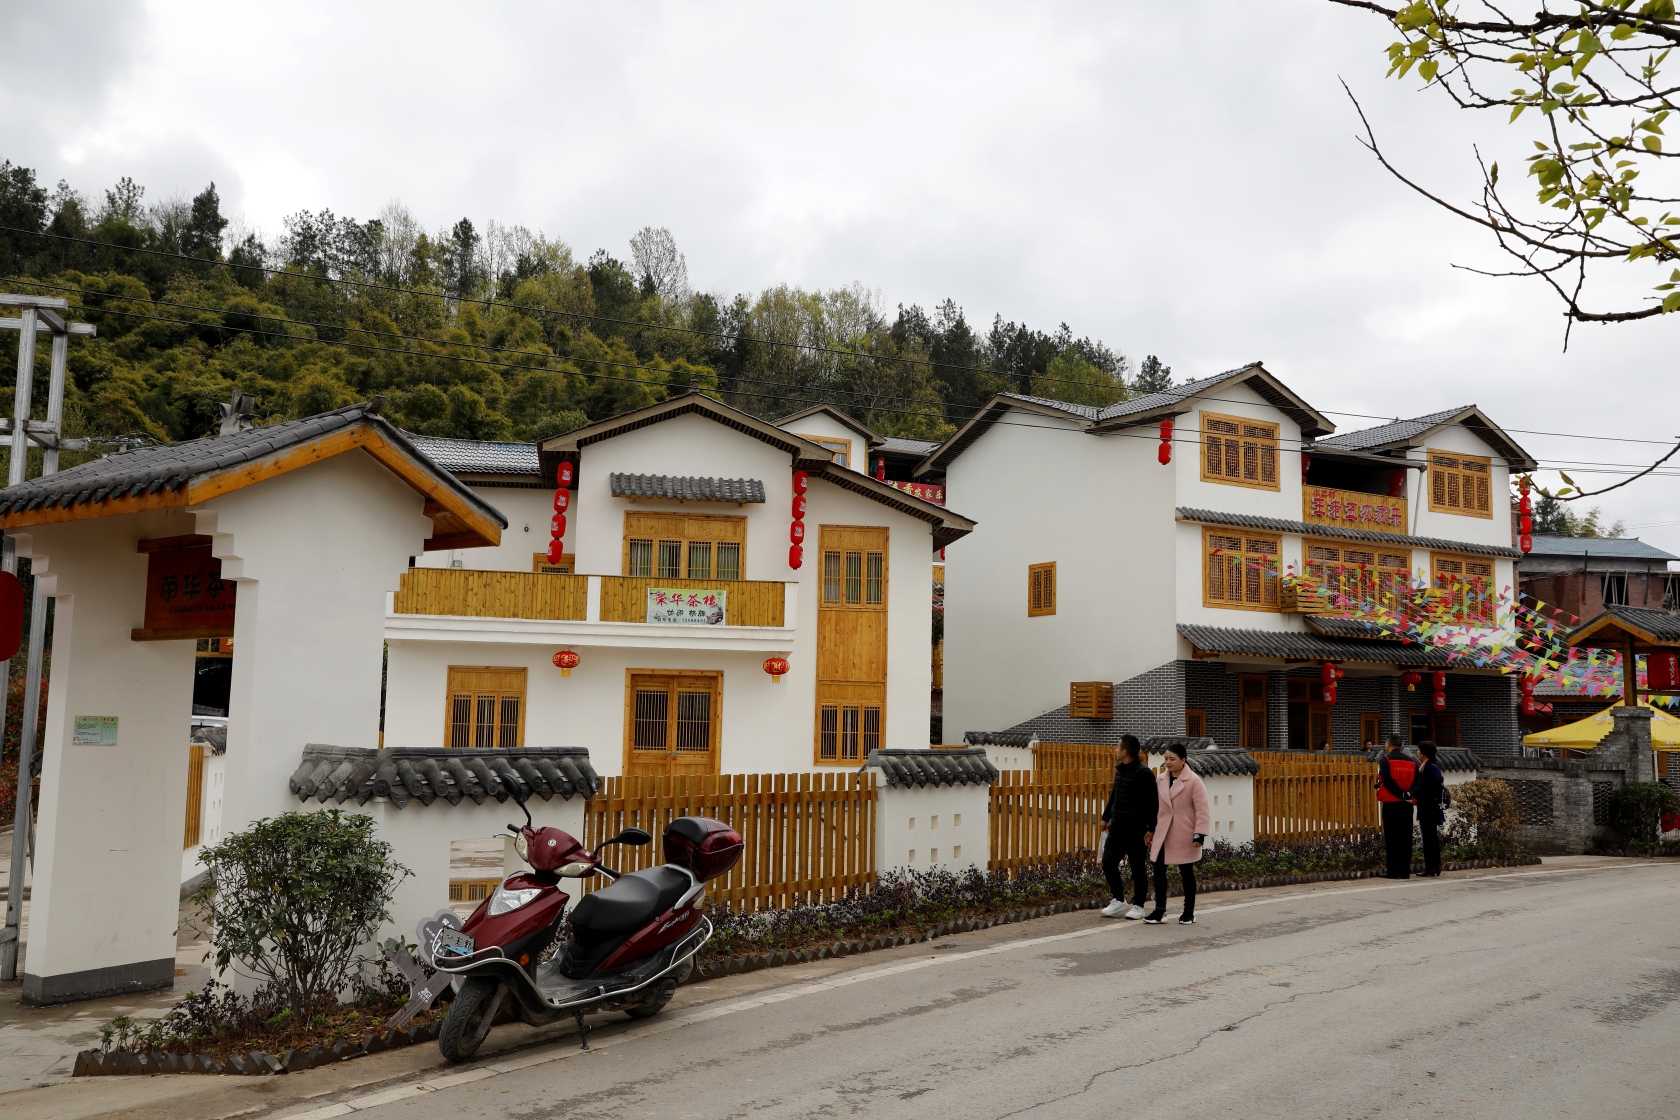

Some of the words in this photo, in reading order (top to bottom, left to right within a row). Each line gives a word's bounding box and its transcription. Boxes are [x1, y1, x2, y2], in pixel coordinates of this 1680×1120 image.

[1312, 498, 1402, 526] 王老五农家乐
[161, 569, 237, 602] 荣华茶
[655, 591, 719, 608] 荣华茶楼
